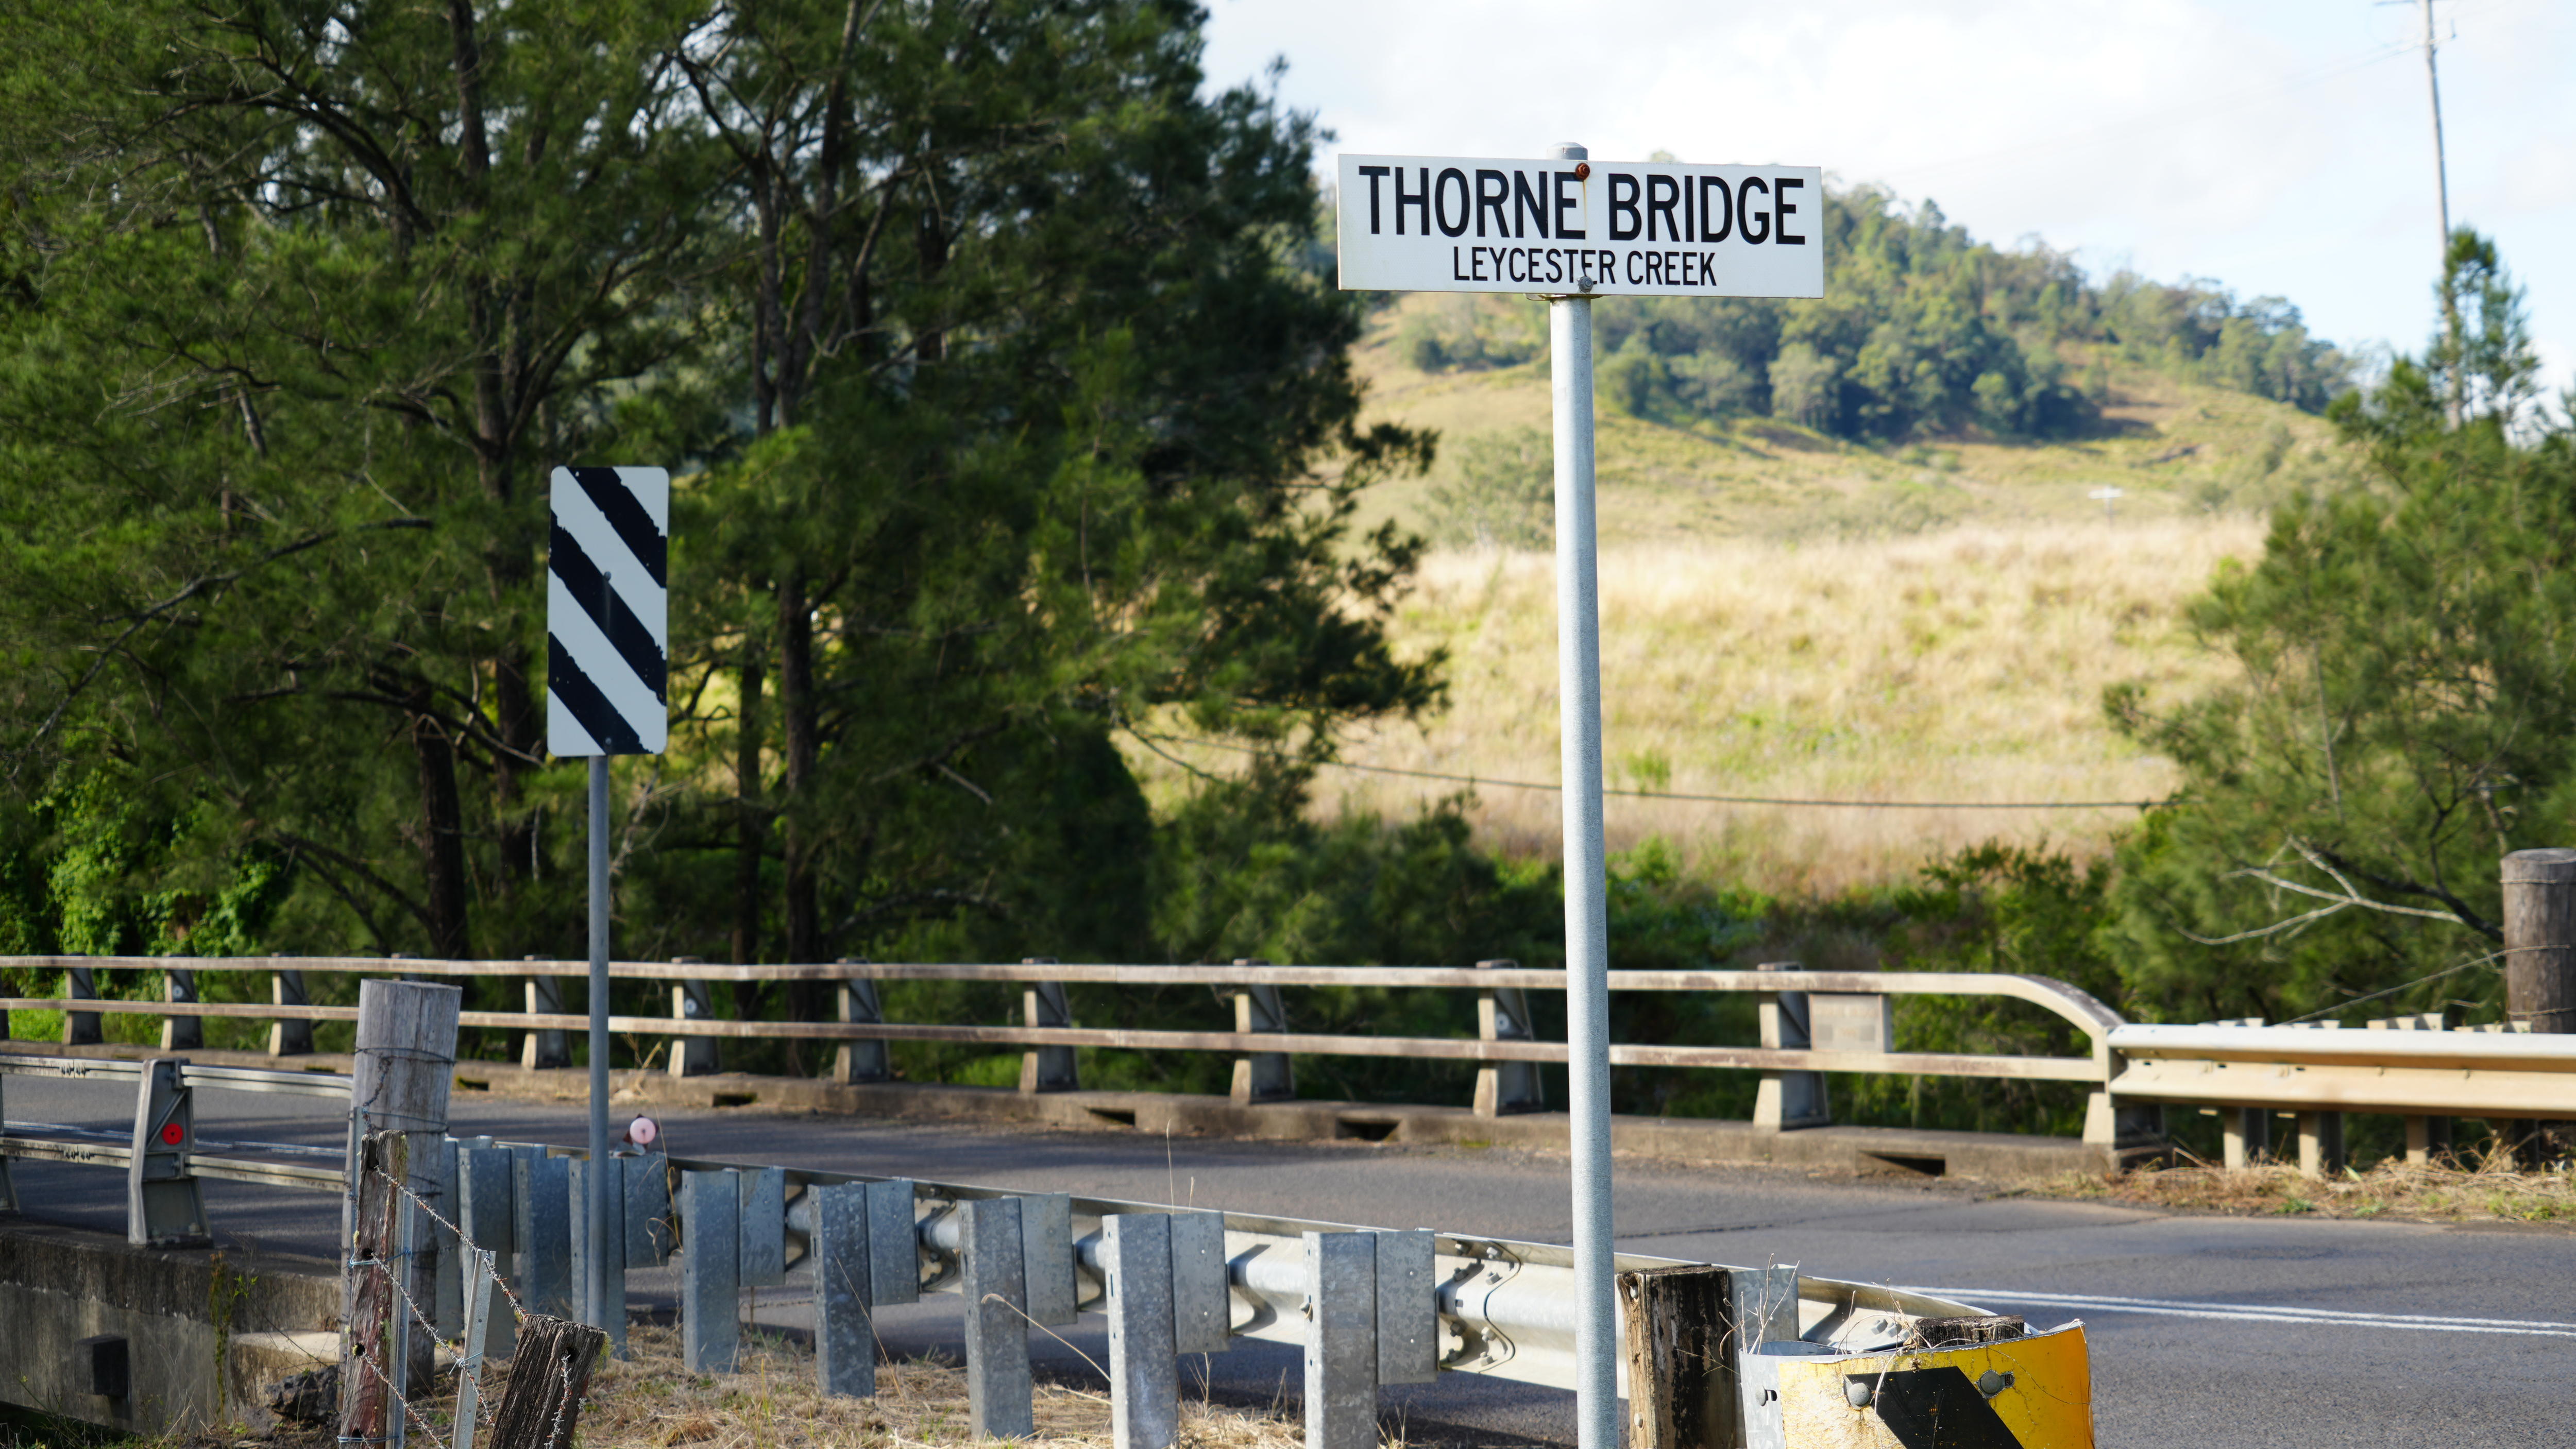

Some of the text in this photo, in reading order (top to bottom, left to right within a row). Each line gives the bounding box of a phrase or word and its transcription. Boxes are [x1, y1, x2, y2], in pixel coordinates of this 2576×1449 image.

[1359, 165, 1805, 245] THORNE BRIDGE
[1453, 246, 1717, 286] LEYCESTER CREEK
